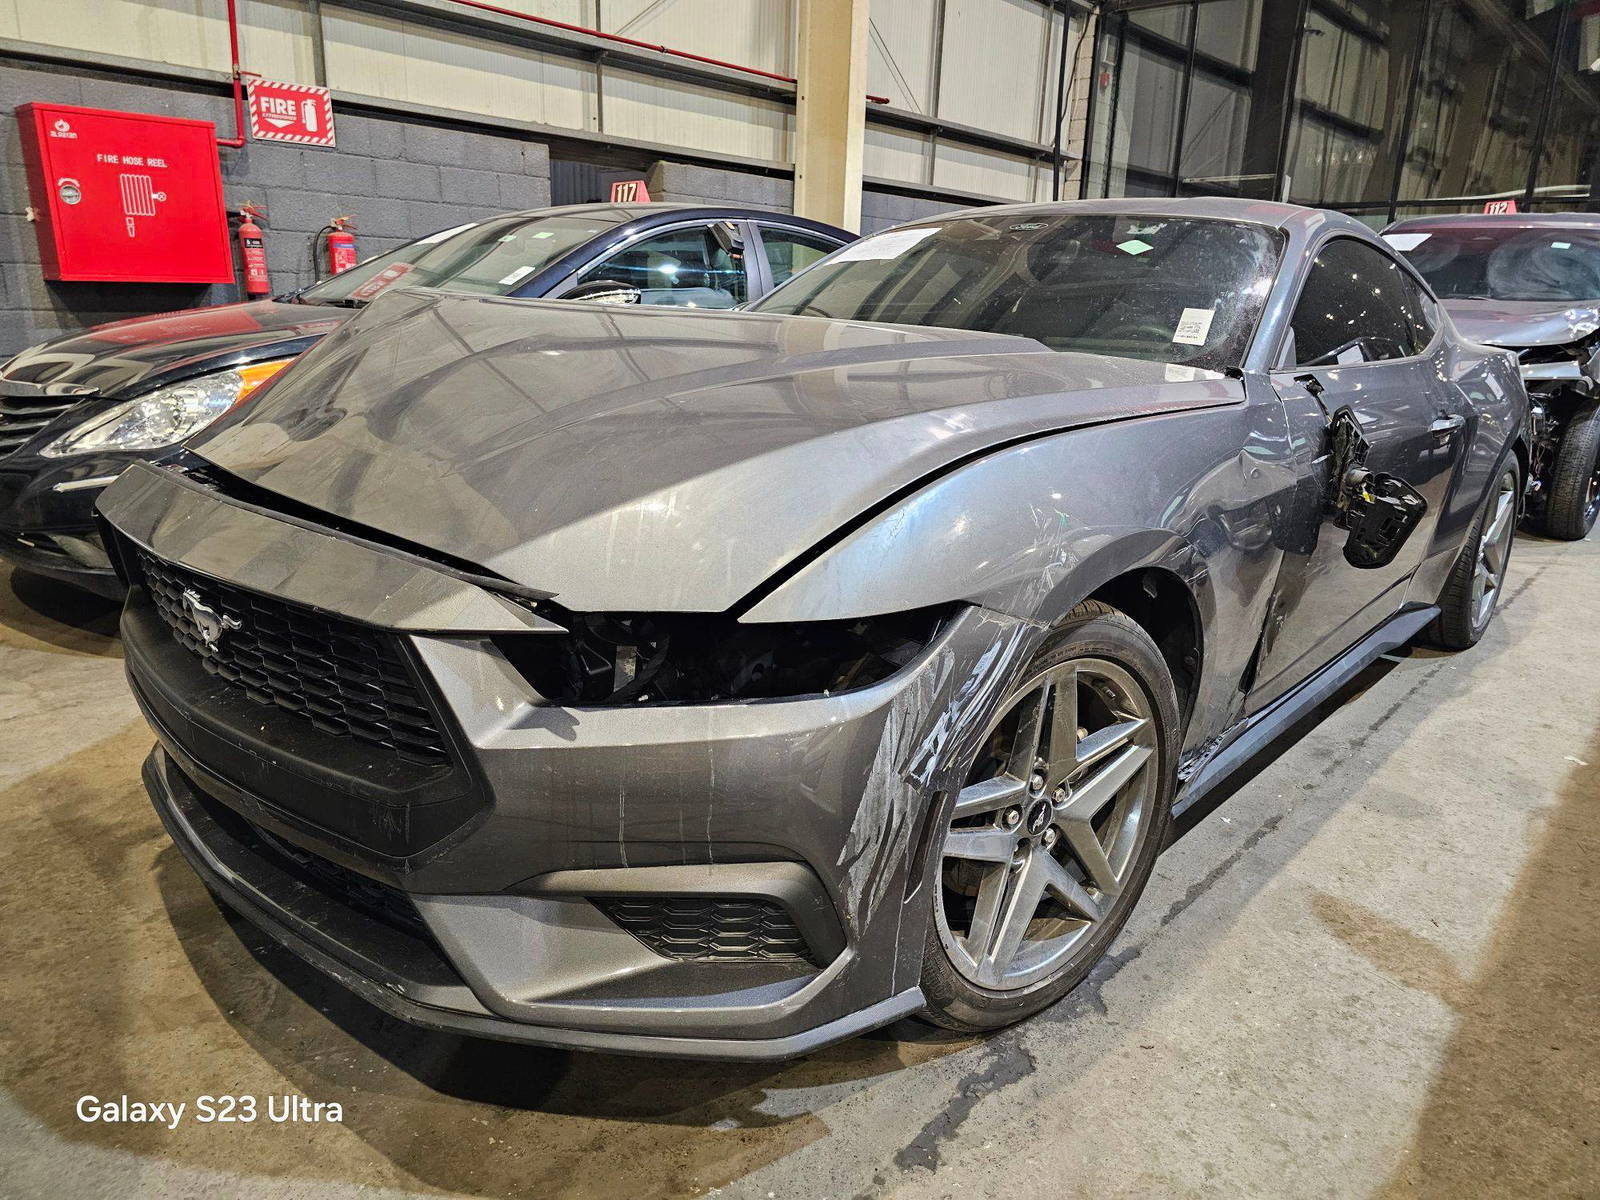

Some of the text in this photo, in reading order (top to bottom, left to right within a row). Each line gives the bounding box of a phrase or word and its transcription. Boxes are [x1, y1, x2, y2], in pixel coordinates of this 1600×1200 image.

[260, 96, 296, 116] FIRE
[96, 153, 168, 168] FIRE HOSE REEL
[616, 183, 637, 203] 117
[1489, 201, 1508, 215] 112
